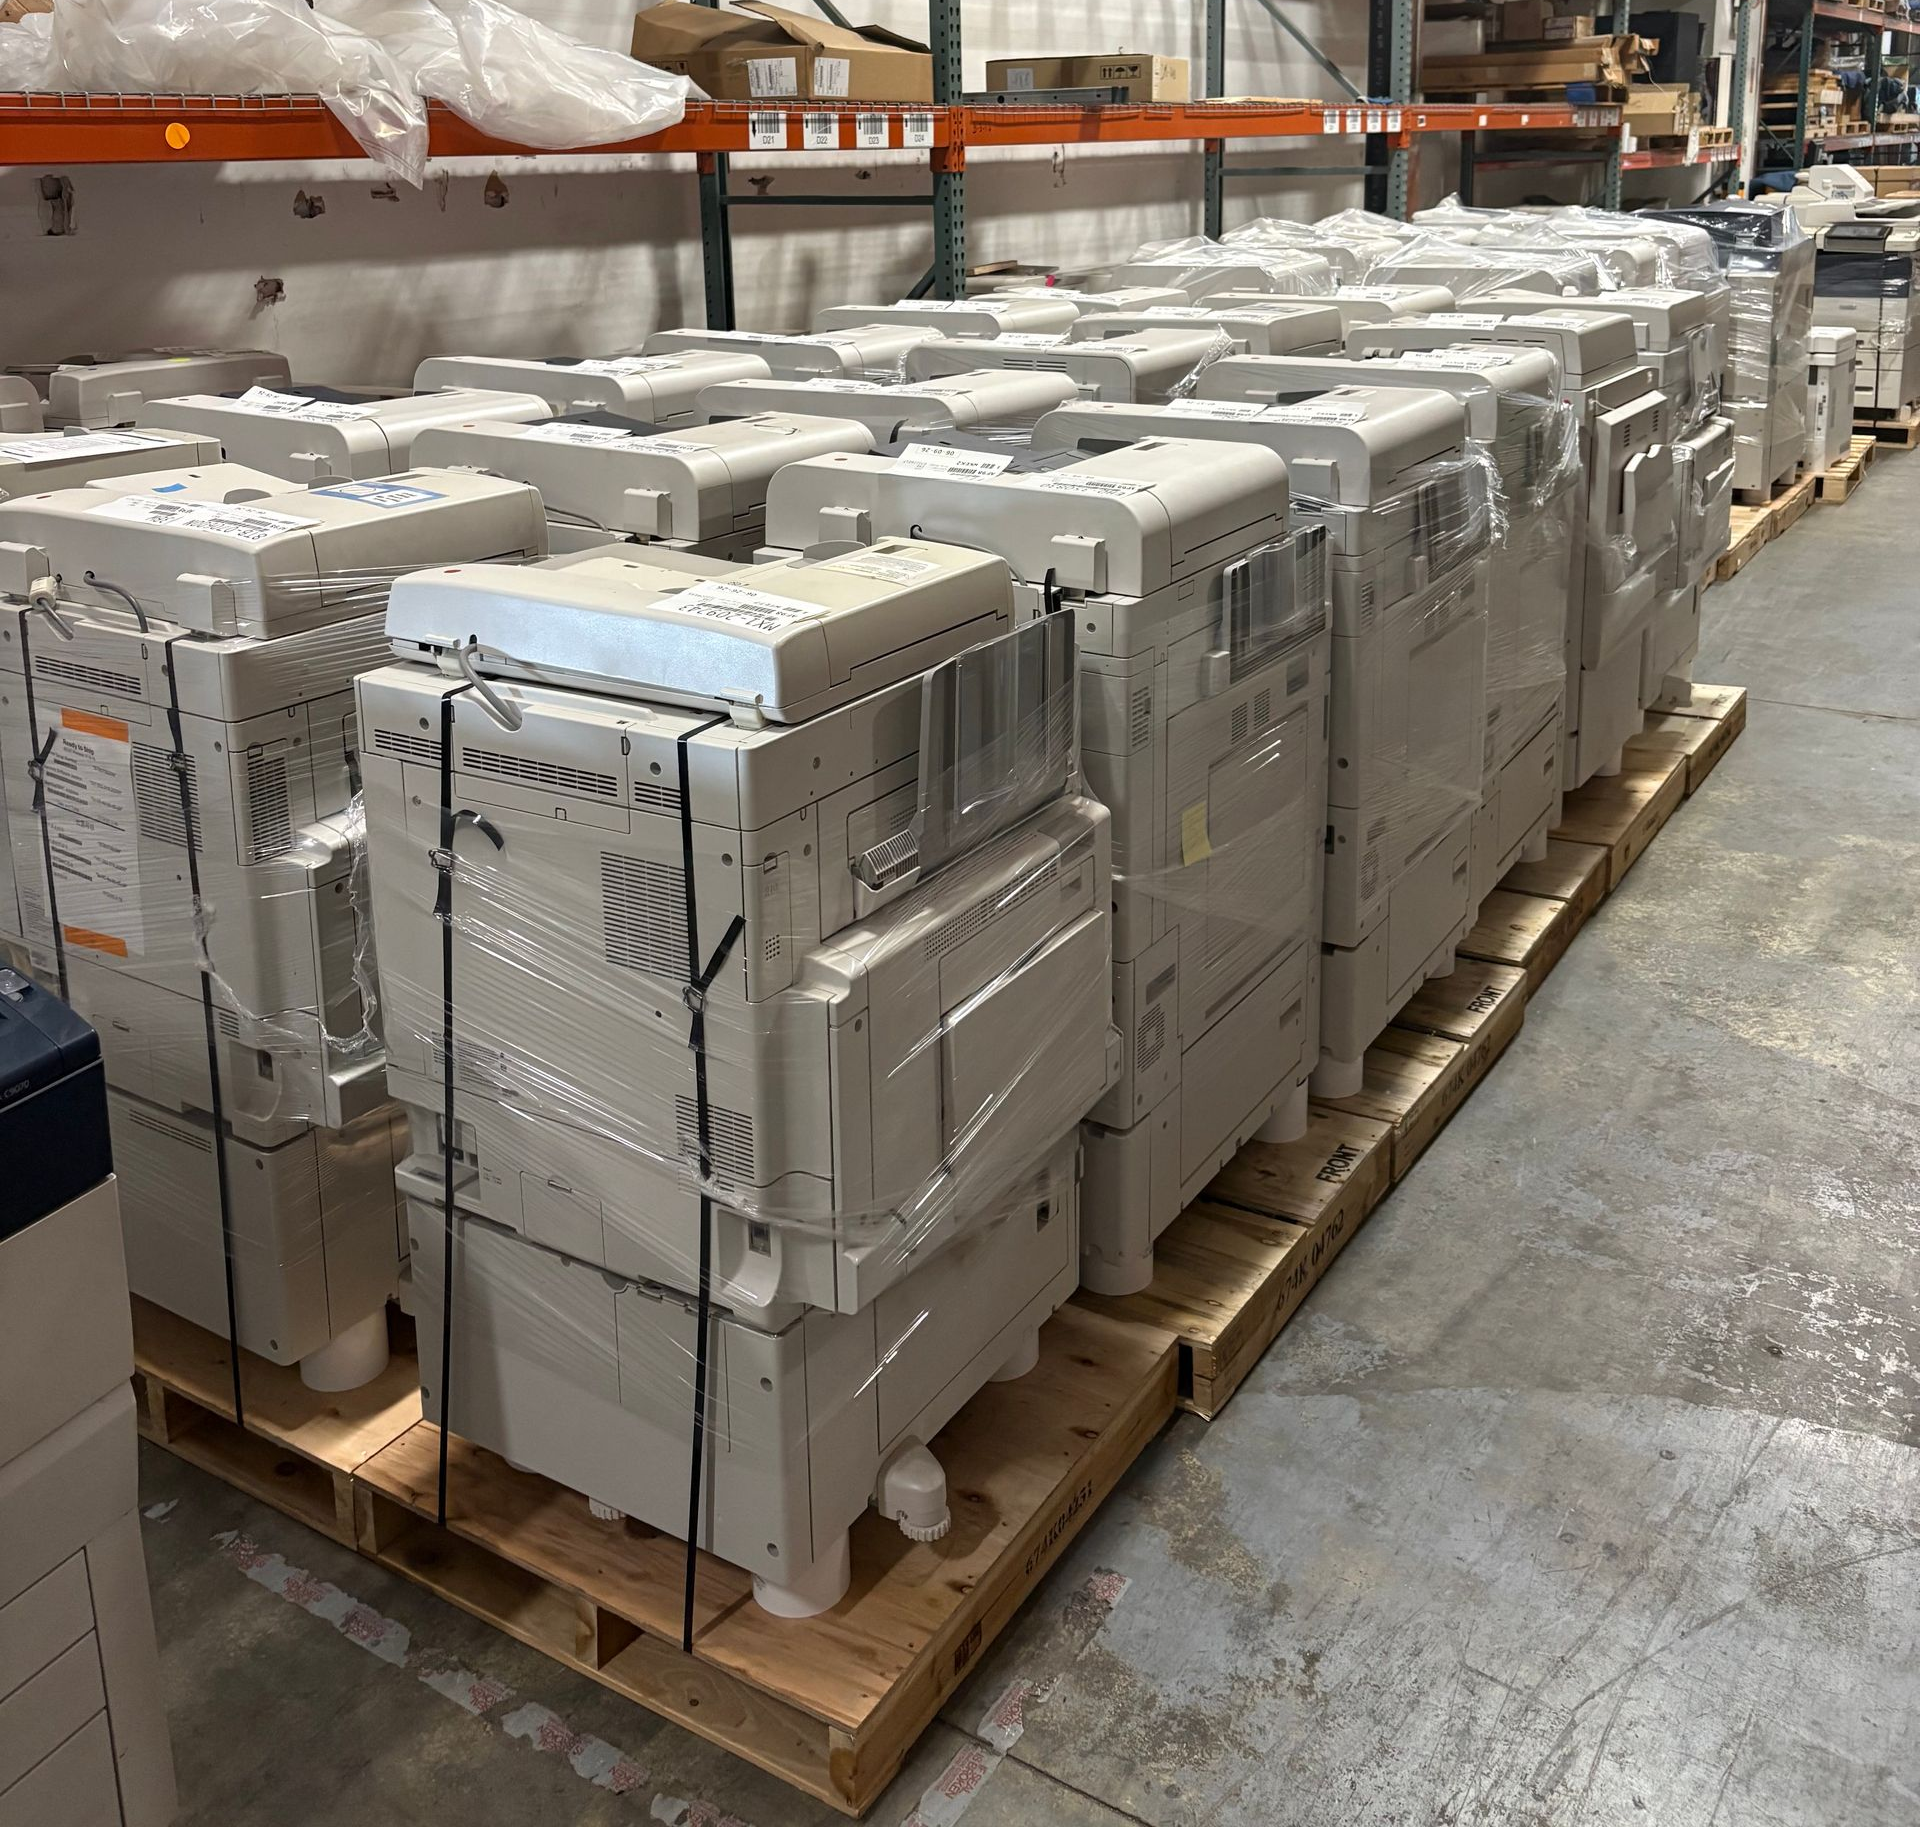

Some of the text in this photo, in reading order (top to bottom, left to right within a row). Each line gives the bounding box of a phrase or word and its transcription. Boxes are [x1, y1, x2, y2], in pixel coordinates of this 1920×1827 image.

[762, 136, 776, 145] D21
[816, 136, 828, 145] D22
[868, 137, 880, 145] D23
[914, 134, 925, 143] D24
[921, 447, 955, 456] 06-09-26
[1466, 985, 1506, 1015] FRONT
[1315, 1143, 1362, 1184] FRONT
[1310, 1208, 1345, 1267] 04762
[945, 1762, 978, 1800] BROKEN
